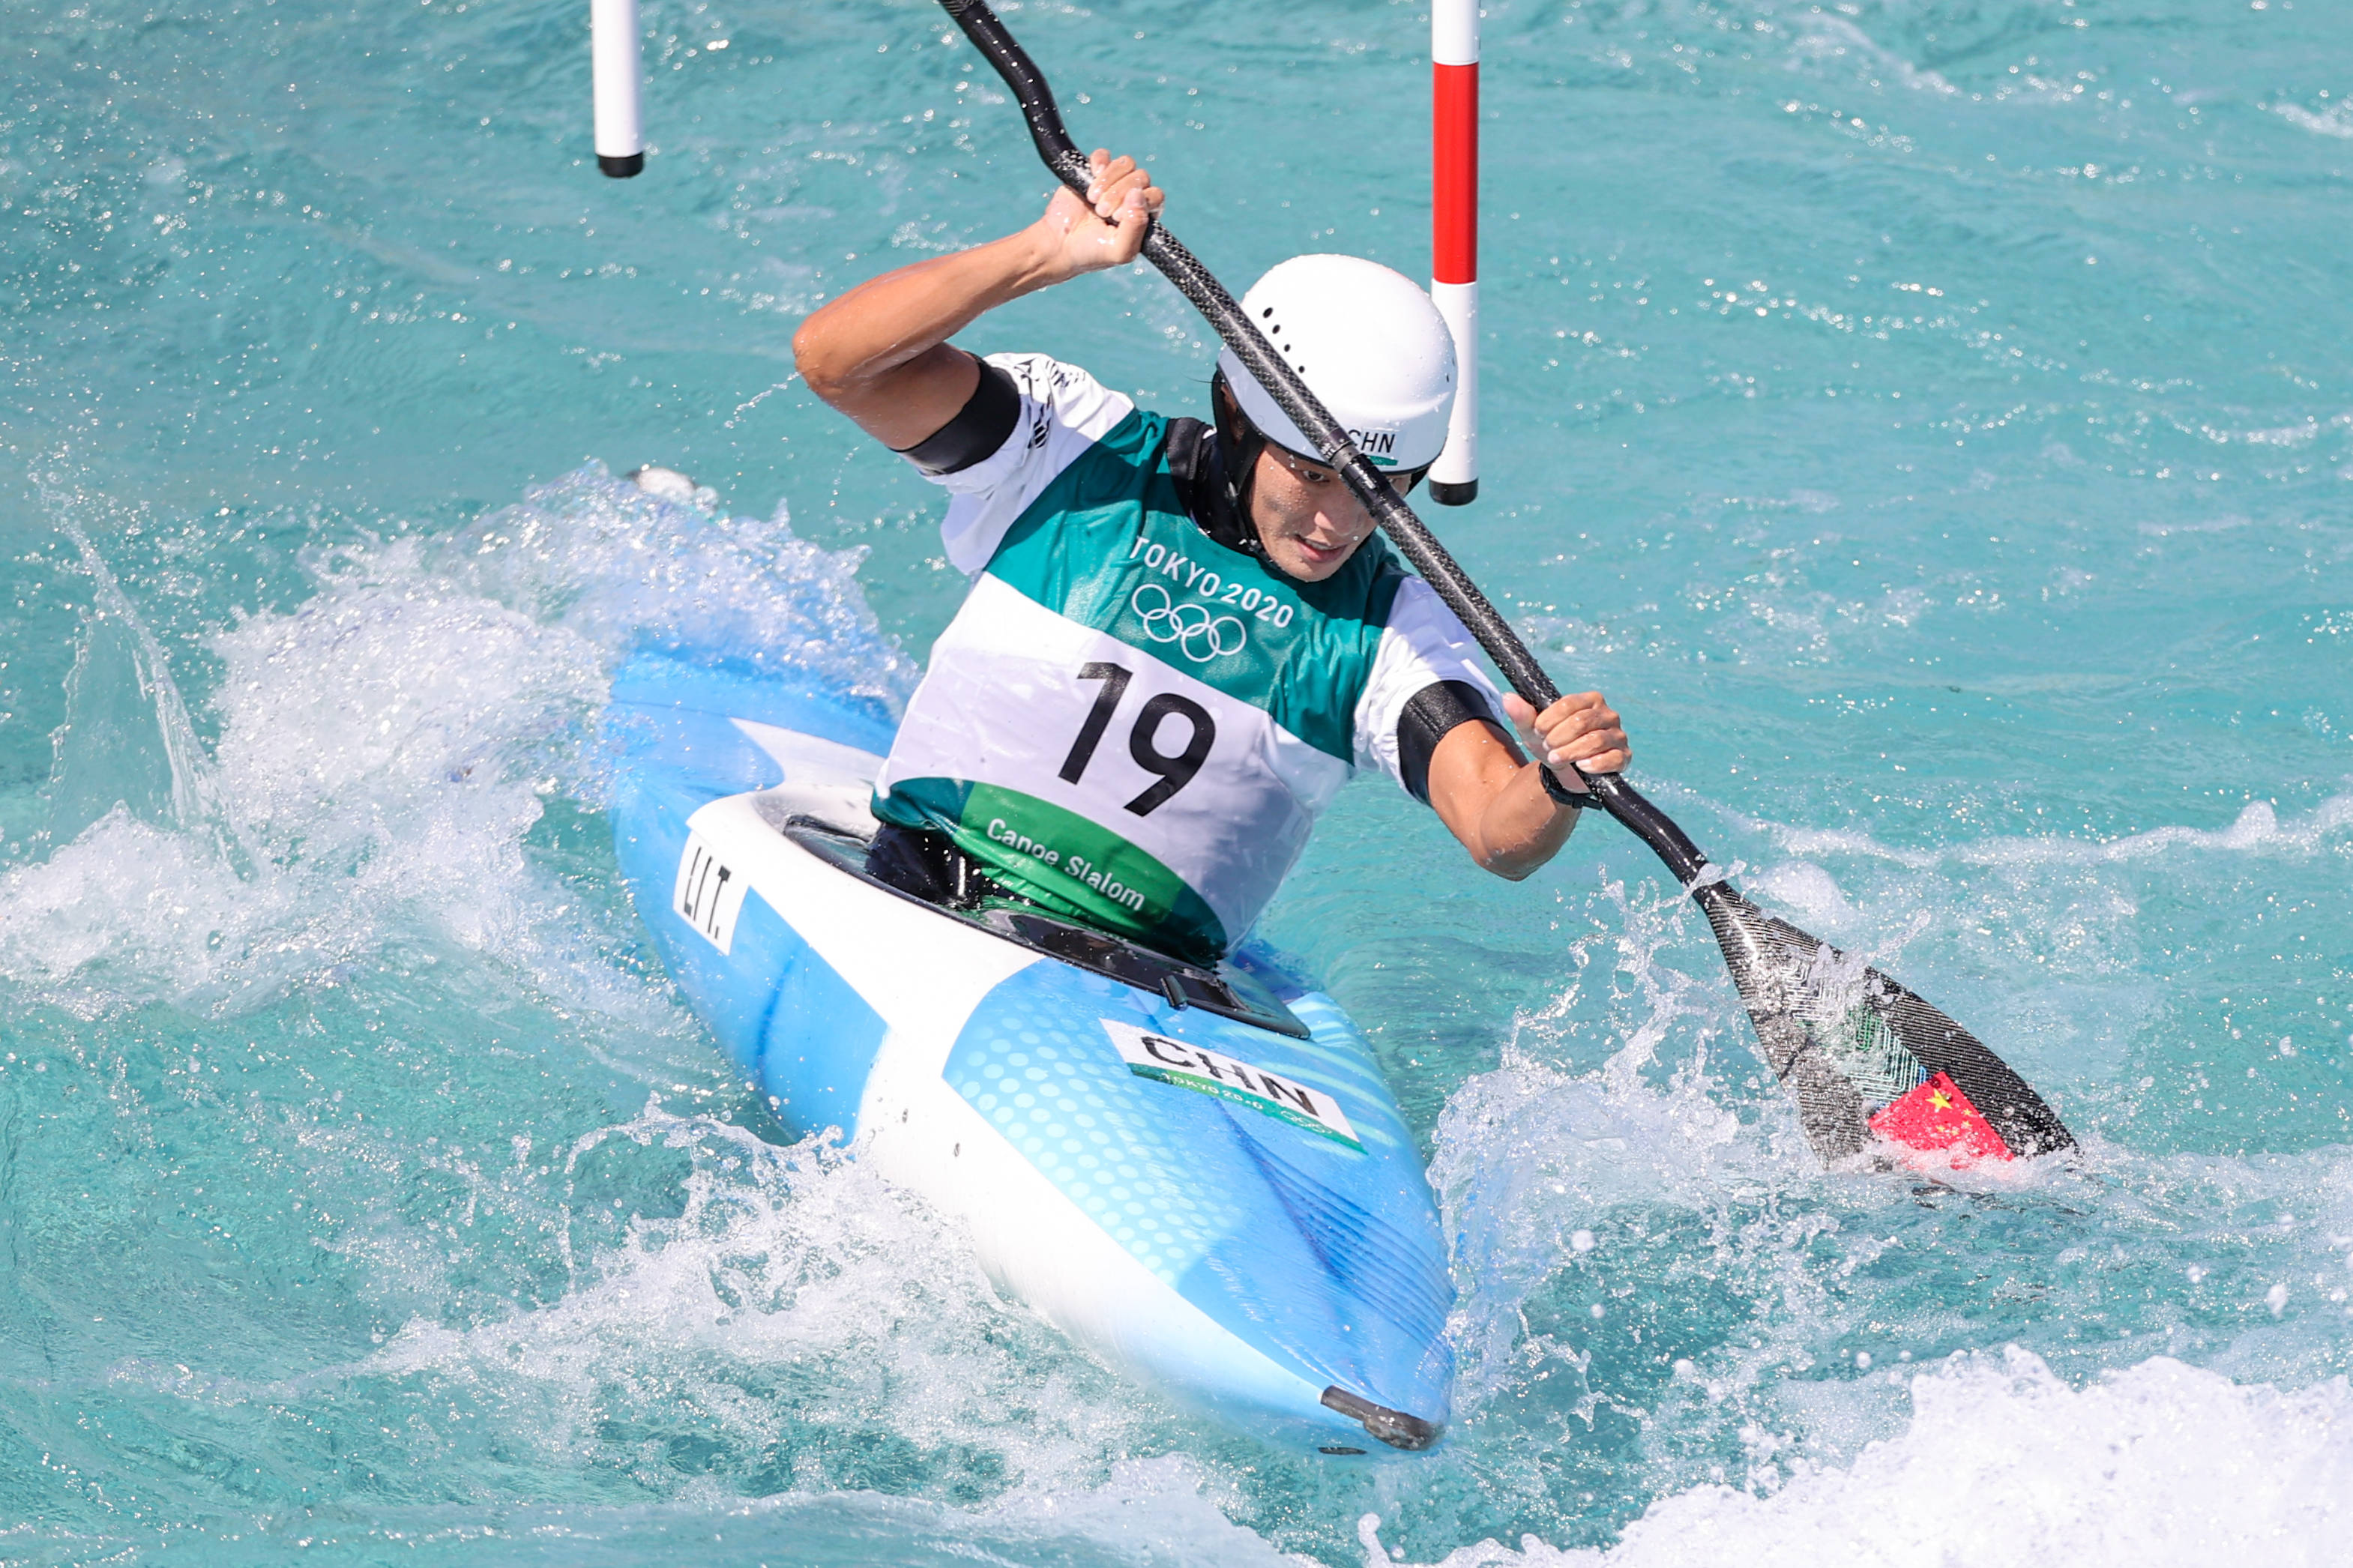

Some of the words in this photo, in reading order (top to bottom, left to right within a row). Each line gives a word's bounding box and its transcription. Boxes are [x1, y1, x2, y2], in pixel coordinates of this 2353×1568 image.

[1129, 535, 1221, 597] TOKYO
[1220, 583, 1295, 628] 2020
[1058, 662, 1216, 818] 19
[986, 818, 1060, 866] Canoe
[1064, 855, 1146, 911] Slalom
[1141, 1036, 1320, 1118] CHN
